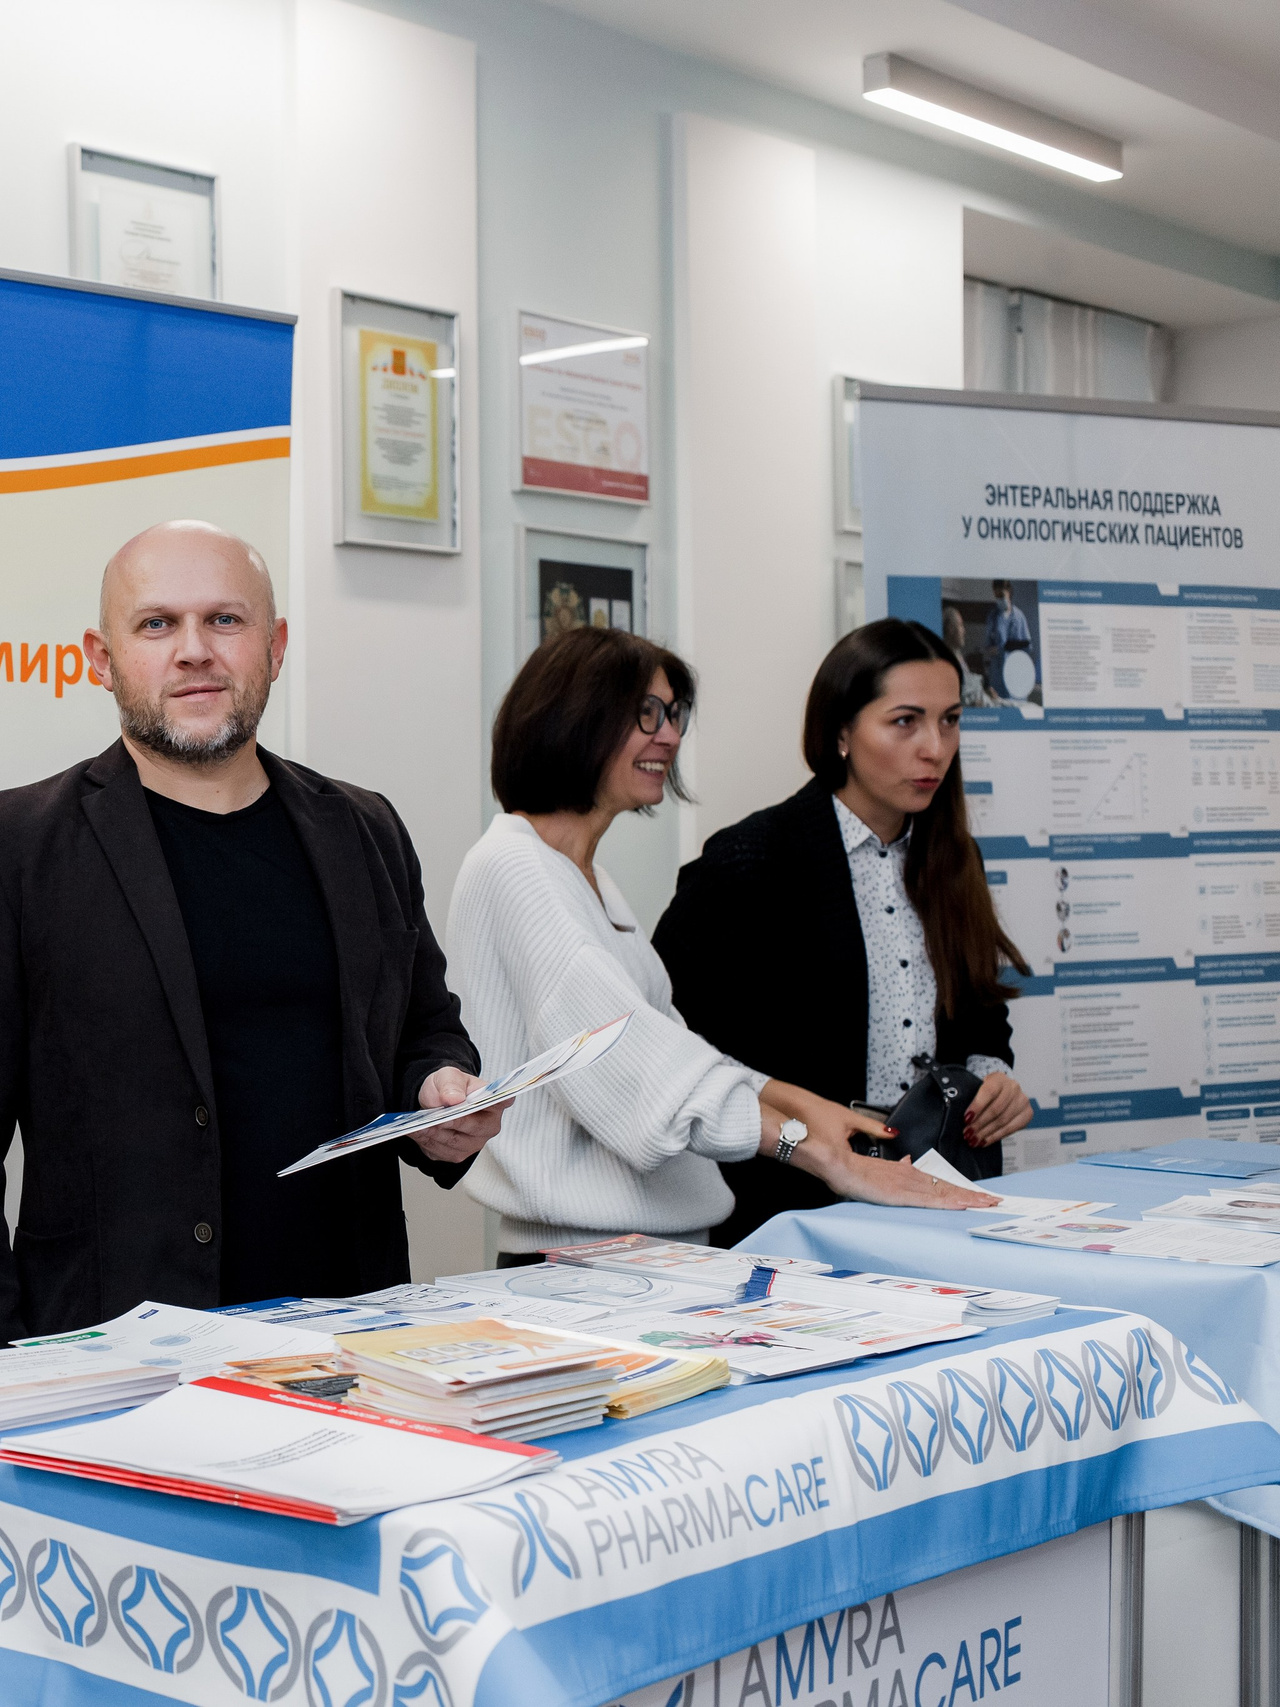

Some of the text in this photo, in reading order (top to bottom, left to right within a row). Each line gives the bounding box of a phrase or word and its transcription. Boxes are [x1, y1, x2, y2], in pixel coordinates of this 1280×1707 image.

[984, 483, 1222, 519] ЭНТЕРАЛЬНАЯ ПОДДЕРЖКА
[962, 516, 1244, 551] У ОНКОЛОГИЧЕСКИХ ПАЦИЕНТОВ
[538, 1441, 726, 1511] LAMYRA
[584, 1456, 830, 1577] PHARMACARE
